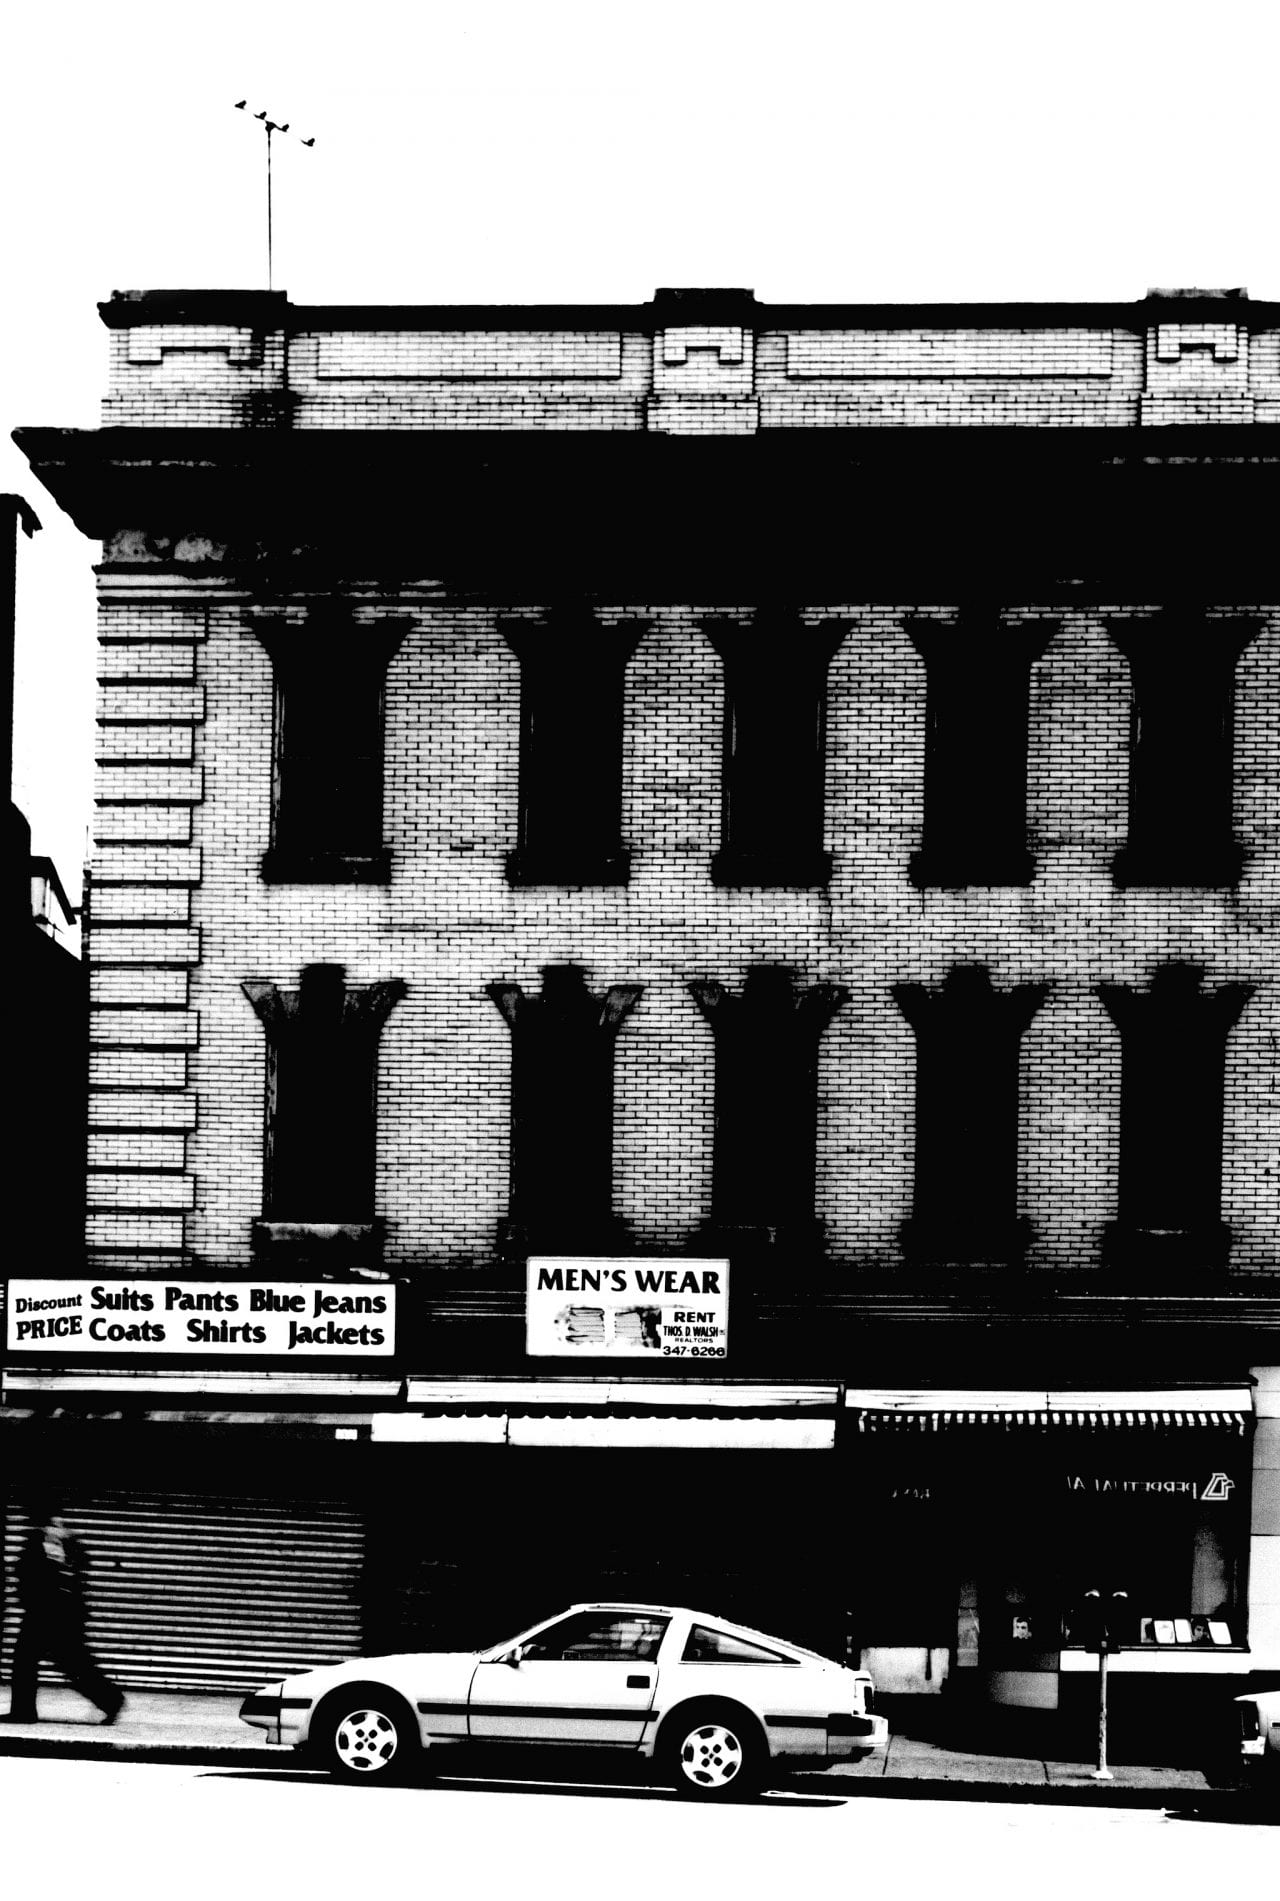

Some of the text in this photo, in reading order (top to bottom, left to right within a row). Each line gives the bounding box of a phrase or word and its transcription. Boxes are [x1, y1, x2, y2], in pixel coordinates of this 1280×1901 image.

[537, 1268, 721, 1293] MEN'S WEAR
[15, 1294, 82, 1313] Discount
[91, 1286, 387, 1318] Suits Pants Blue Jeans
[16, 1315, 82, 1340] PRICE
[674, 1312, 716, 1323] RENT
[89, 1318, 385, 1349] Coats Shirts Jackets
[692, 1326, 719, 1337] WALSH
